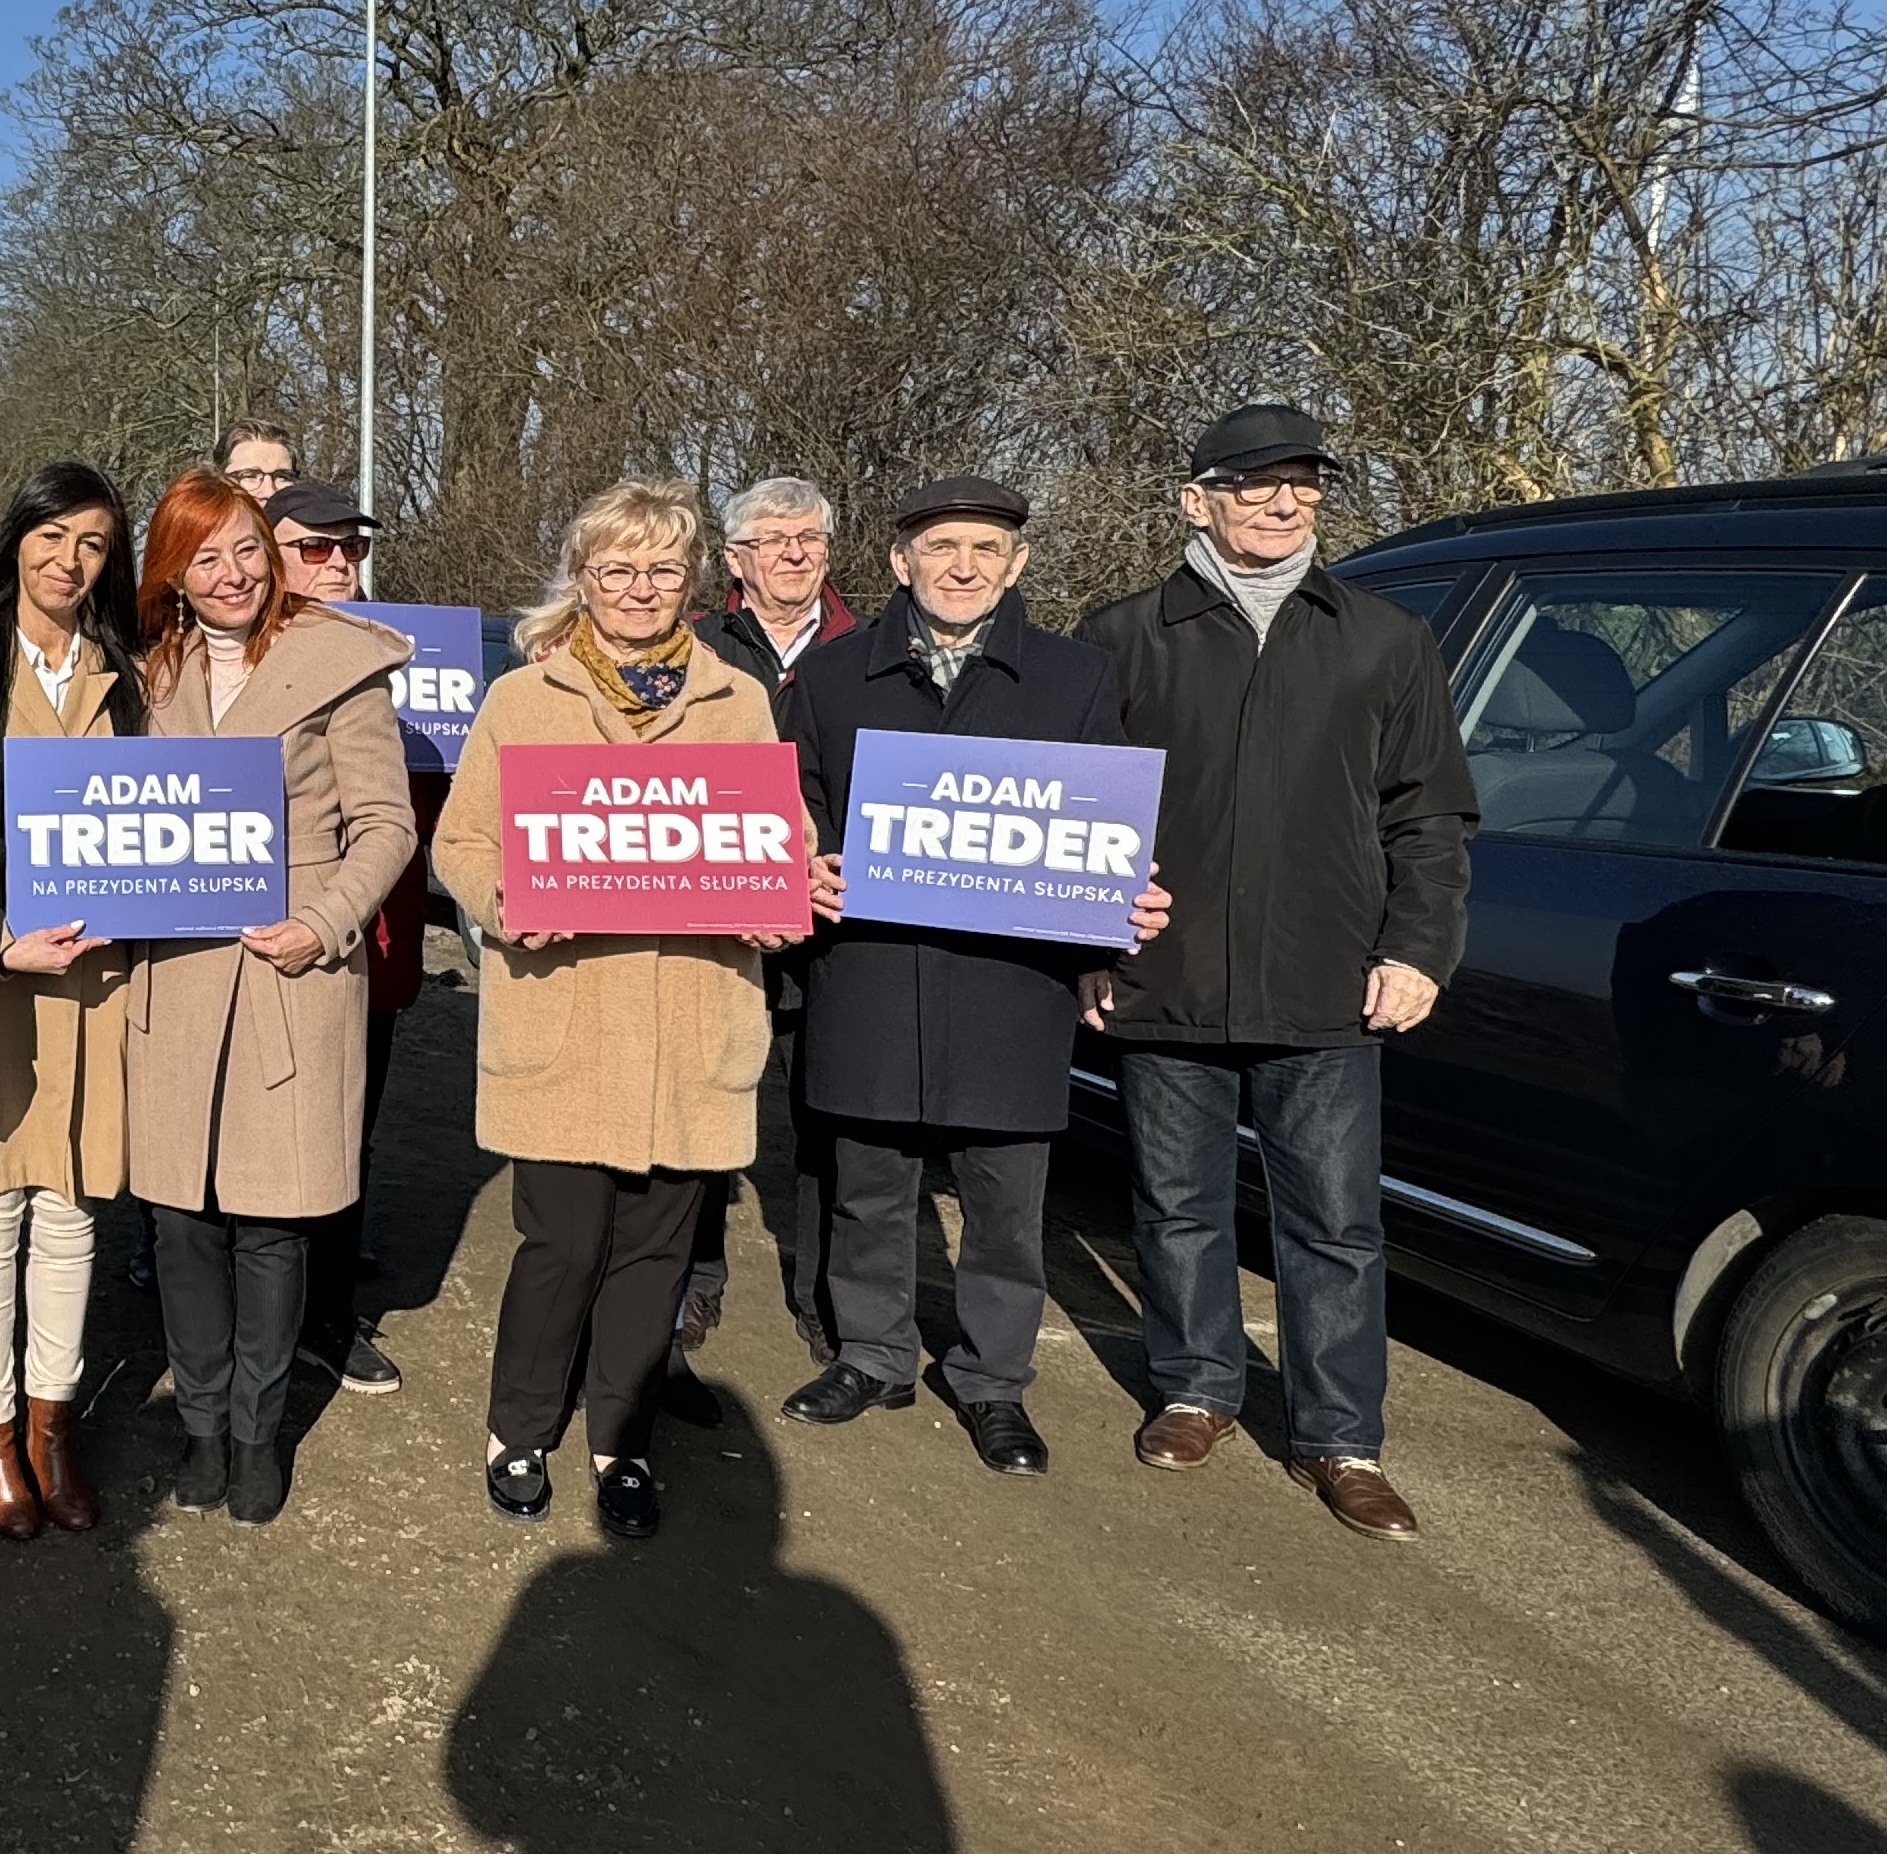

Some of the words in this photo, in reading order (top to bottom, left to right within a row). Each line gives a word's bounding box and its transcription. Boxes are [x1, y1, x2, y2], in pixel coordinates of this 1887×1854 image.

[405, 721, 469, 736] SŁUPSKA
[82, 773, 201, 806] ADAM
[582, 777, 709, 806] ADAM
[930, 771, 1063, 810] ADAM
[17, 811, 275, 867] TREDER
[514, 813, 794, 864] TREDER
[861, 802, 1142, 878] TREDER
[32, 879, 58, 896] NA
[65, 878, 181, 895] PREZYDENTA
[188, 877, 268, 893] SŁUPSKA
[531, 875, 558, 891] NA
[567, 875, 692, 891] PREZYDENTA
[699, 875, 788, 891] SŁUPSKA
[867, 864, 894, 881] NA
[902, 869, 1026, 895] PREZYDENTA
[1034, 880, 1125, 904] SŁUPSKA
